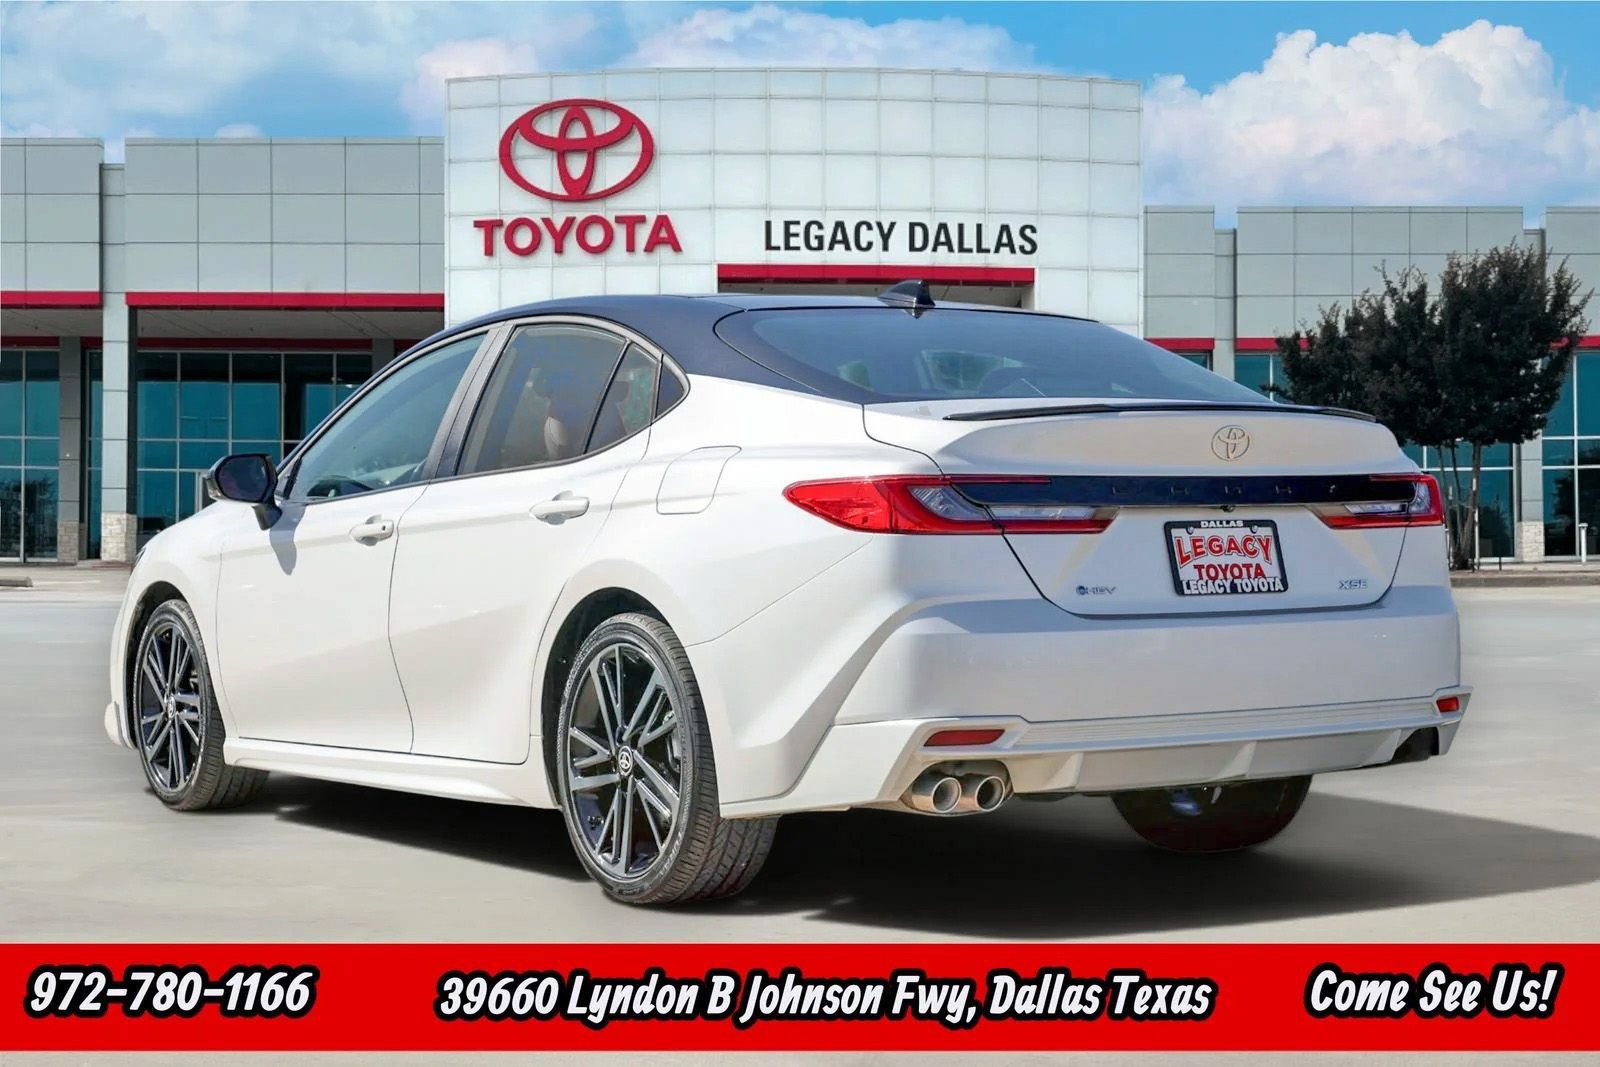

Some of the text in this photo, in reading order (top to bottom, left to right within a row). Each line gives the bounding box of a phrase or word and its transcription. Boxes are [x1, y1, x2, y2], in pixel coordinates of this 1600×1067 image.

[474, 214, 682, 257] TOYOTA
[765, 220, 1038, 255] LEGACY DALLAS
[1200, 520, 1244, 528] DALLAS
[1174, 534, 1273, 568] LEGACY
[1193, 563, 1266, 581] TOYOTA
[1182, 577, 1285, 595] LEGACY TOYOTA
[1338, 579, 1368, 590] XSE
